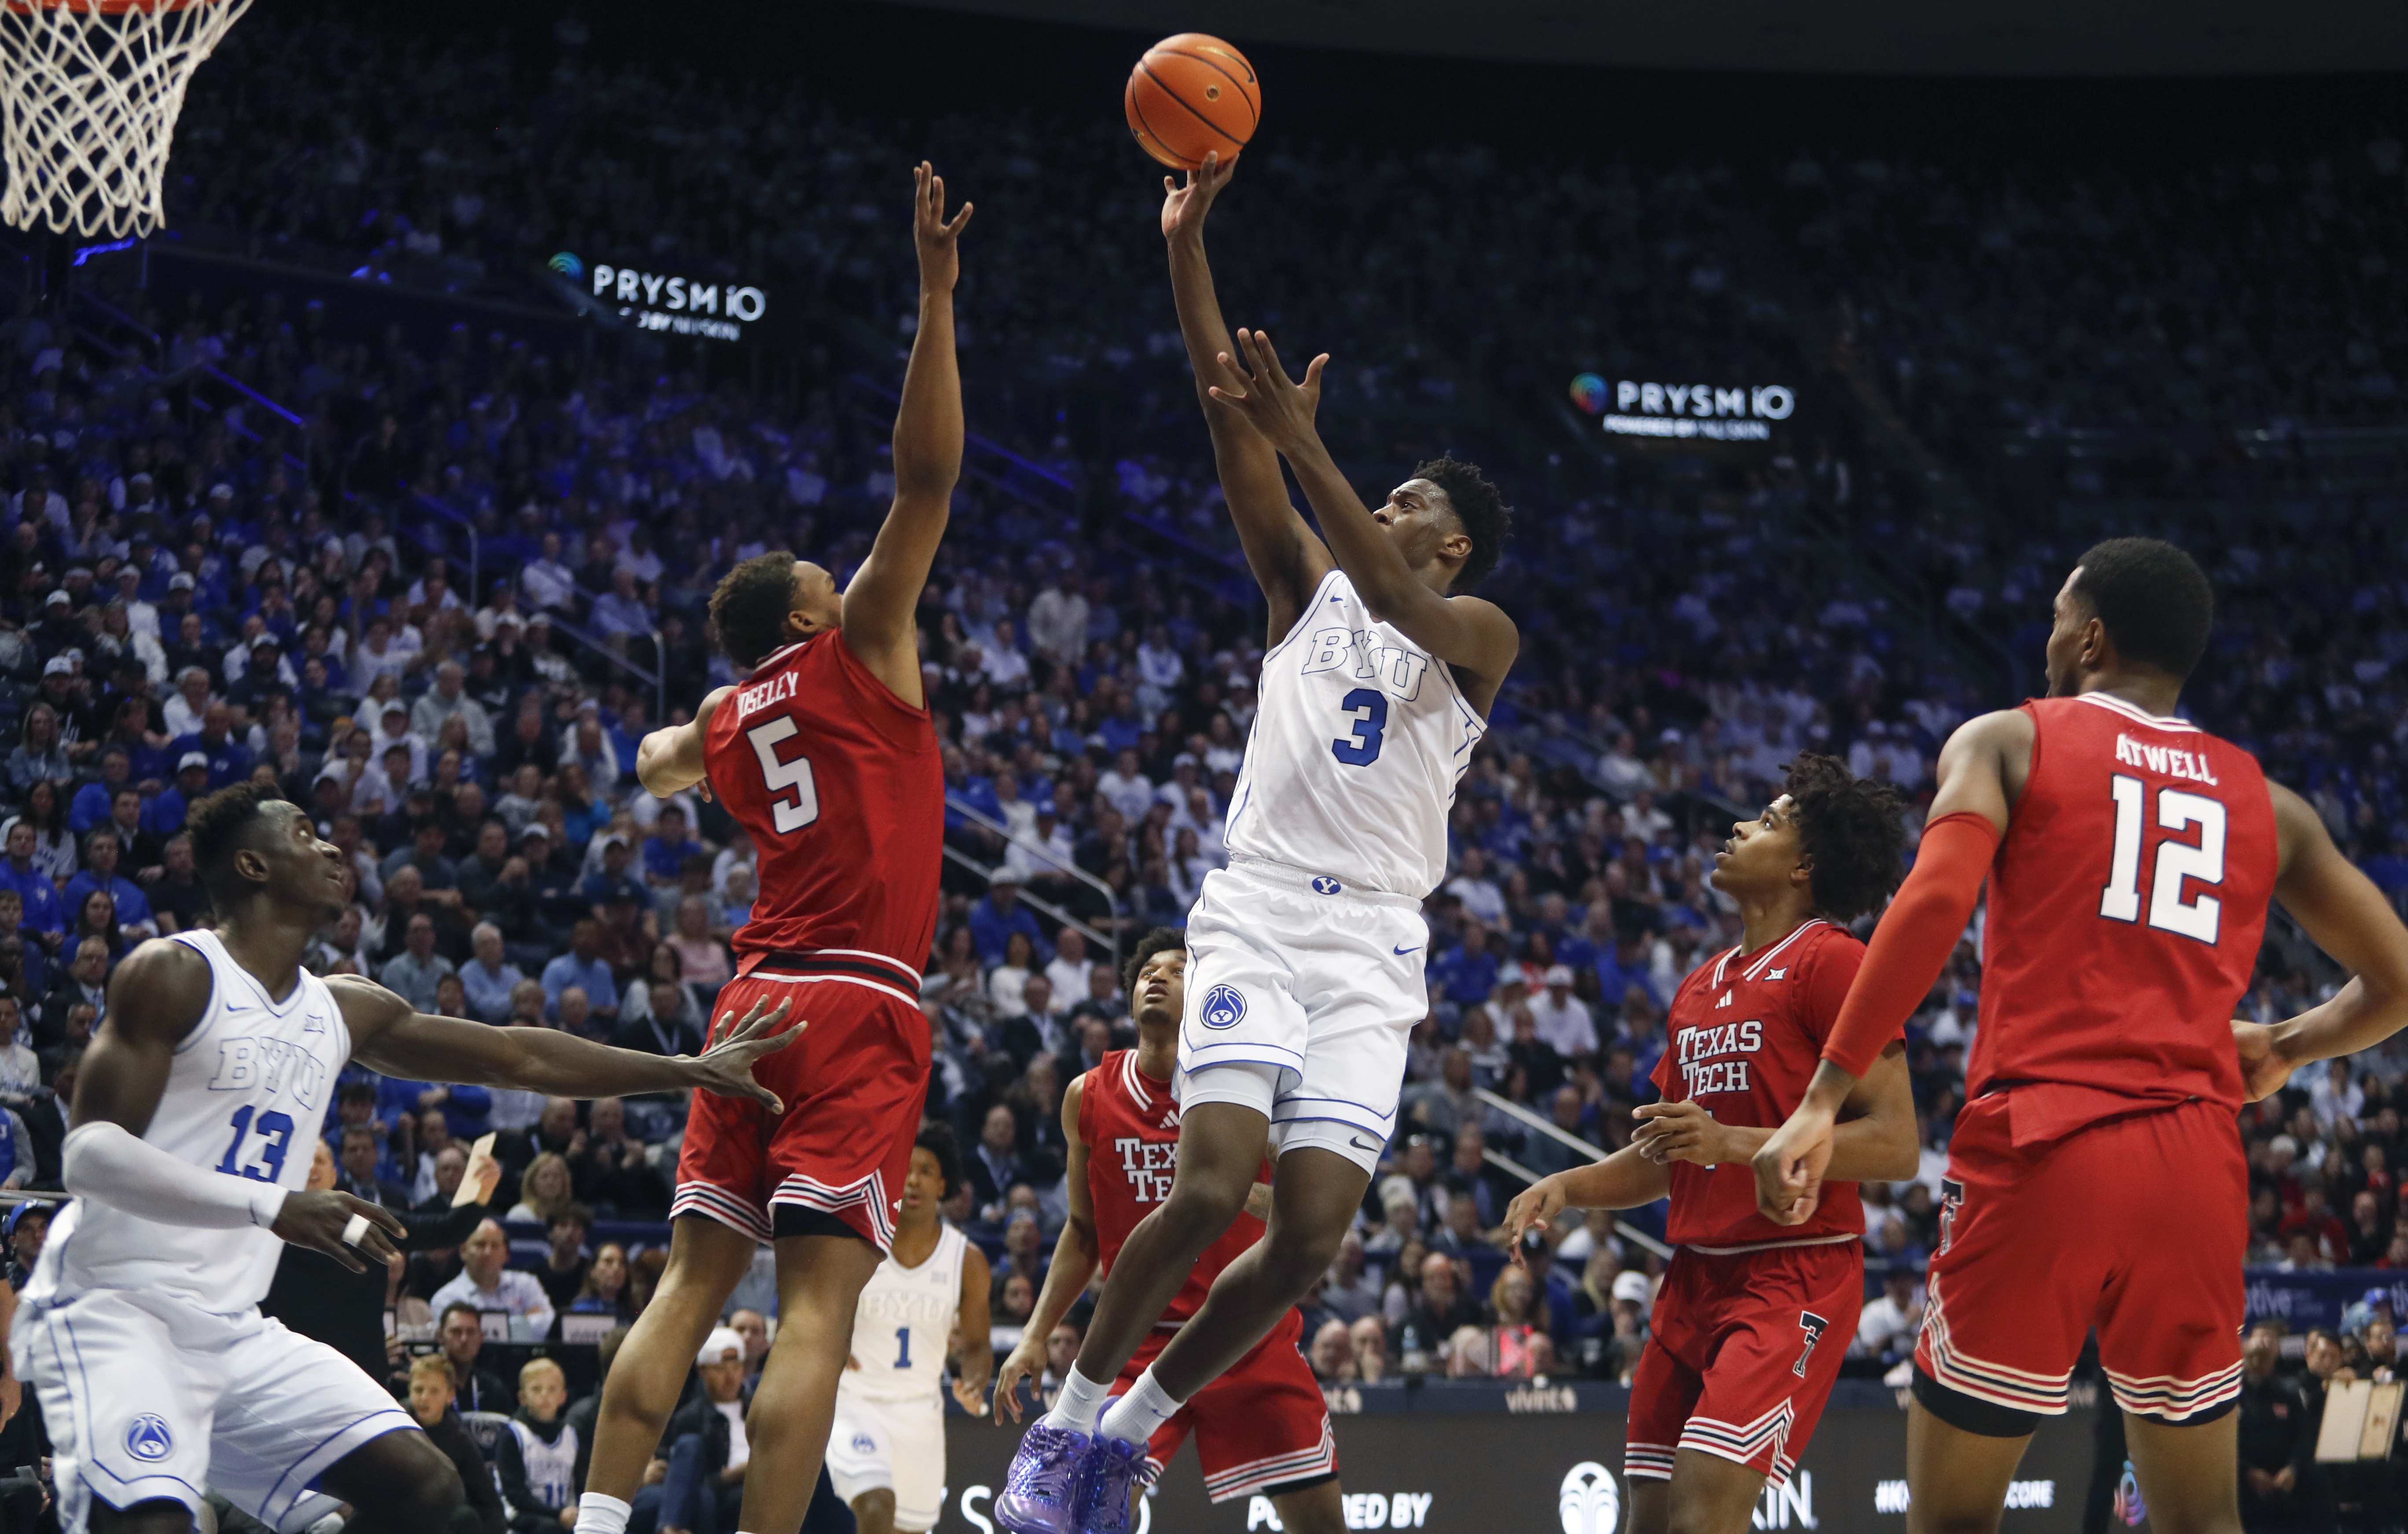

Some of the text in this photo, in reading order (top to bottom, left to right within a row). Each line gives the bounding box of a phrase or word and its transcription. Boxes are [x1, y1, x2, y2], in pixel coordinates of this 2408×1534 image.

[594, 264, 718, 315] PRYSM
[1617, 380, 1746, 417] PRYSM
[1301, 627, 1428, 702] BYU
[737, 670, 799, 727] OSELEY
[1331, 688, 1388, 767] 3
[745, 711, 820, 835] 5
[2115, 733, 2218, 787] ATWELL
[2098, 772, 2228, 948] 12
[1676, 1019, 1763, 1065] TEXAS
[208, 1036, 326, 1111] BYU
[1681, 1059, 1750, 1100] TECH
[215, 1104, 295, 1184] 13
[1114, 1138, 1179, 1171] TEX
[1127, 1169, 1173, 1203] TE
[861, 1290, 947, 1321] BYU
[893, 1326, 912, 1369] 1
[1390, 1492, 1433, 1528] BY
